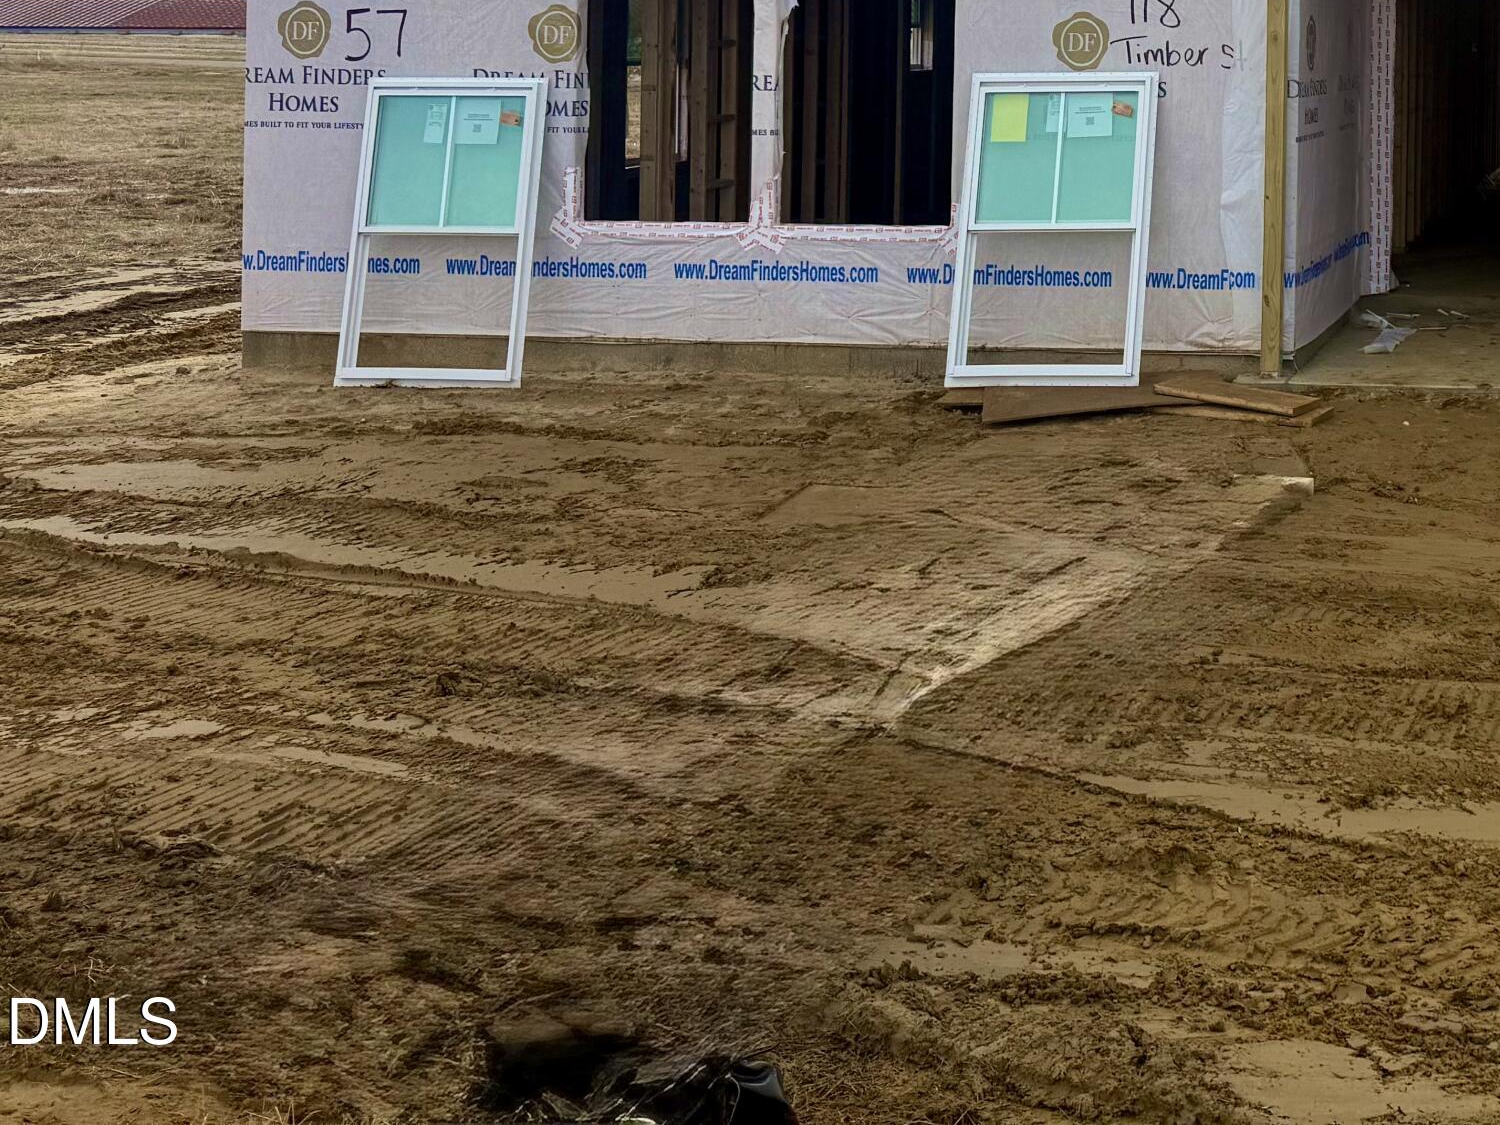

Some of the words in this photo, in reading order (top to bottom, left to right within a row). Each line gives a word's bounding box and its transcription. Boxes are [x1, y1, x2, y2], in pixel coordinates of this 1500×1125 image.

[292, 20, 320, 40] DF
[345, 7, 407, 61] 57
[543, 25, 572, 45] DF
[1068, 33, 1097, 52] DF
[1110, 35, 1208, 66] Timber
[268, 92, 339, 113] HOMES
[674, 259, 879, 284] www.DreamFindersHomes.com
